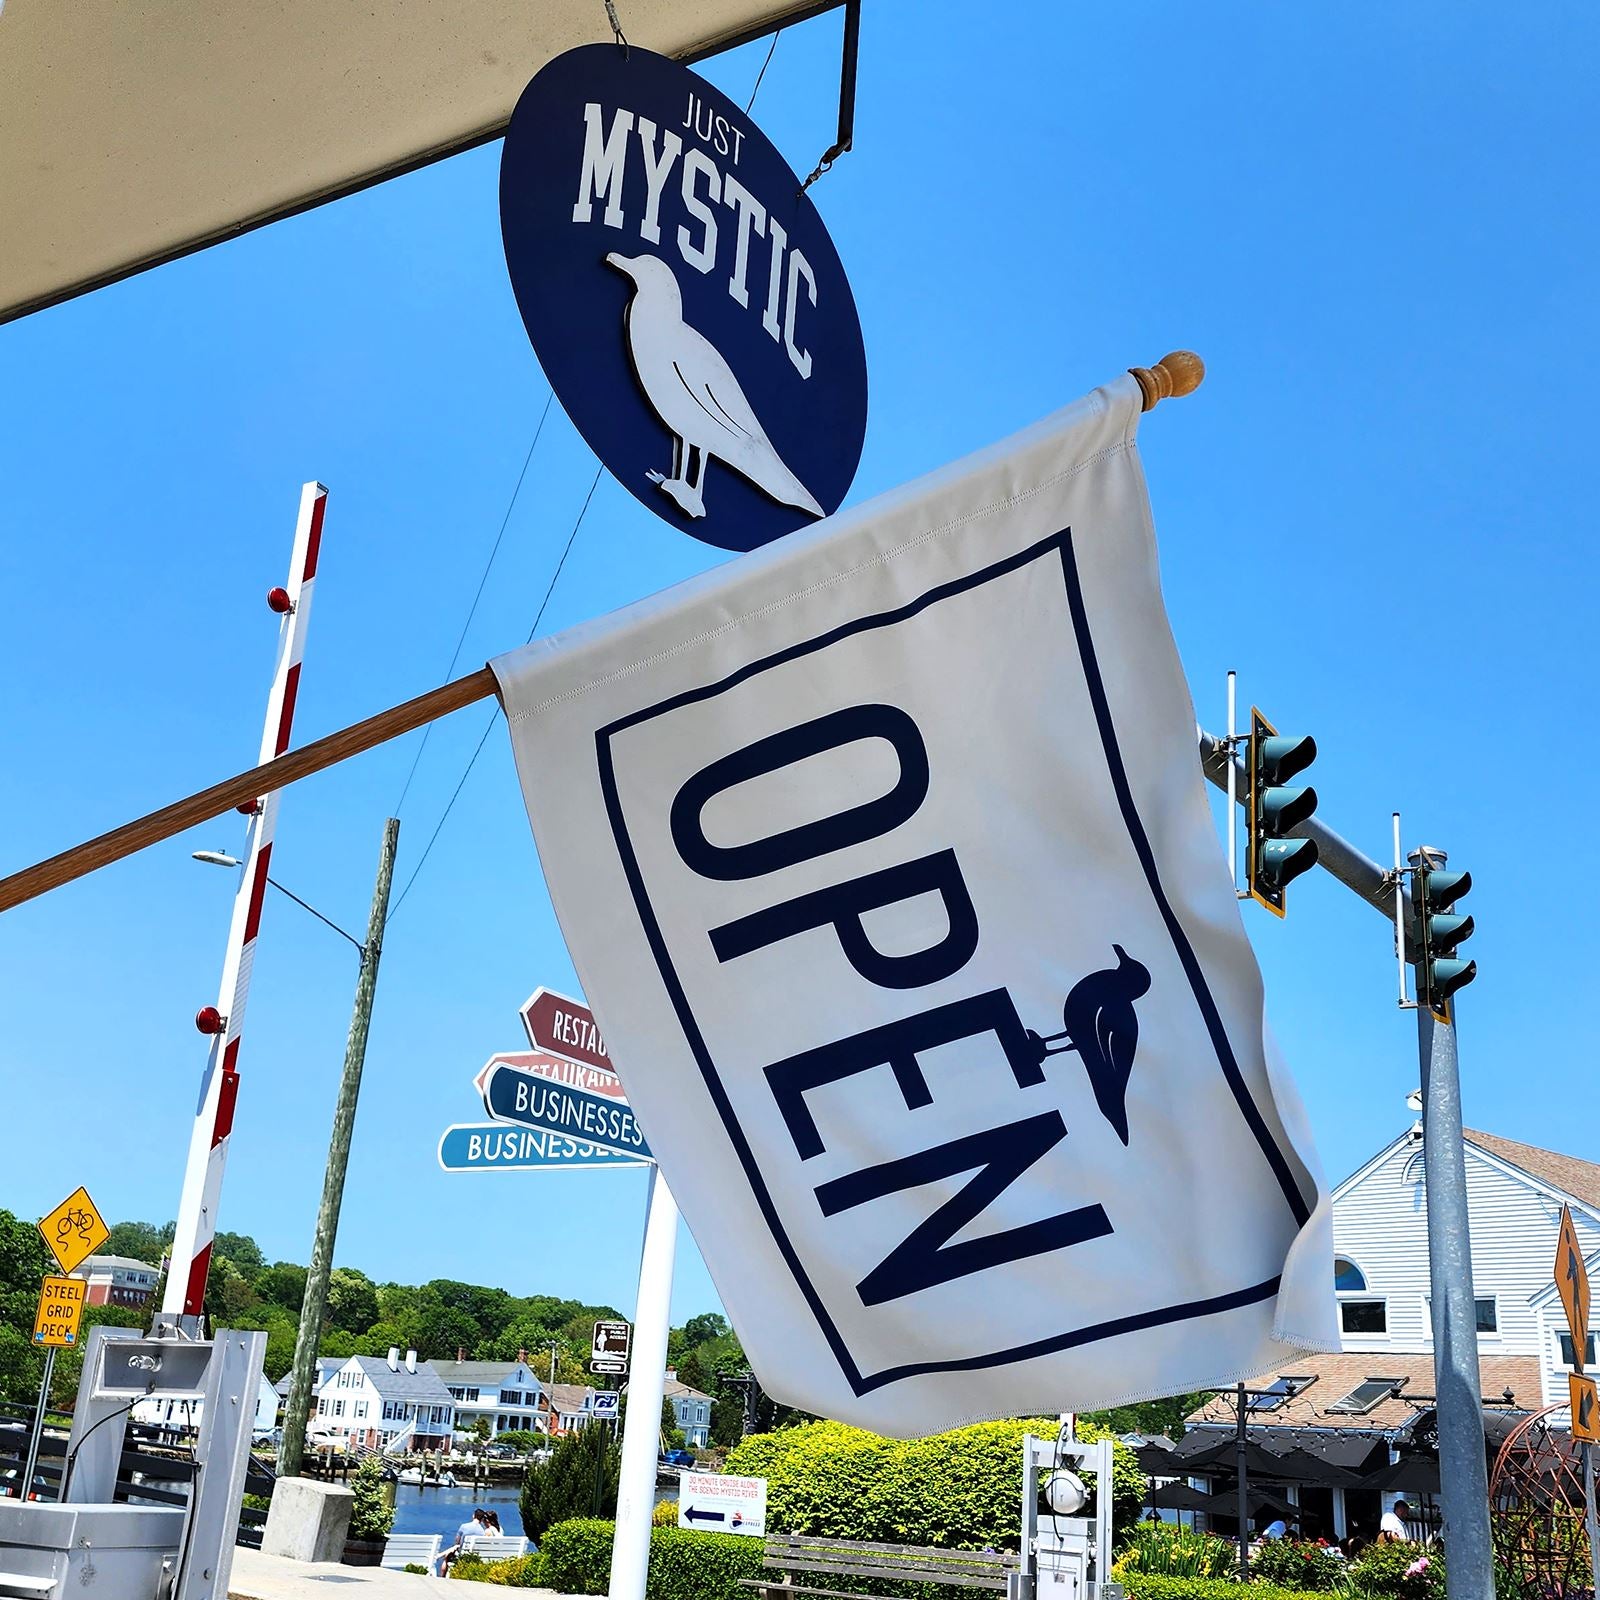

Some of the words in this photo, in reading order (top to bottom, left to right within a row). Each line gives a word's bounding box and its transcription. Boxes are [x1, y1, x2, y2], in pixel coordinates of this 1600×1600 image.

[682, 93, 745, 166] JUST
[572, 103, 818, 380] MYSTIC
[669, 702, 1115, 1308] OPEN
[552, 1010, 609, 1058] RESTAU
[515, 1082, 643, 1147] BUSINESSES
[45, 1285, 80, 1300] STEEL
[47, 1304, 74, 1318] GRID
[41, 1323, 72, 1337] DECK
[689, 1485, 698, 1493] THE
[699, 1486, 719, 1495] SCENIC
[720, 1488, 740, 1497] MYSTIC
[742, 1490, 758, 1498] RIVER
[698, 1477, 718, 1486] MINUTE
[720, 1479, 739, 1488] CRUISE
[740, 1481, 758, 1489] ALONG
